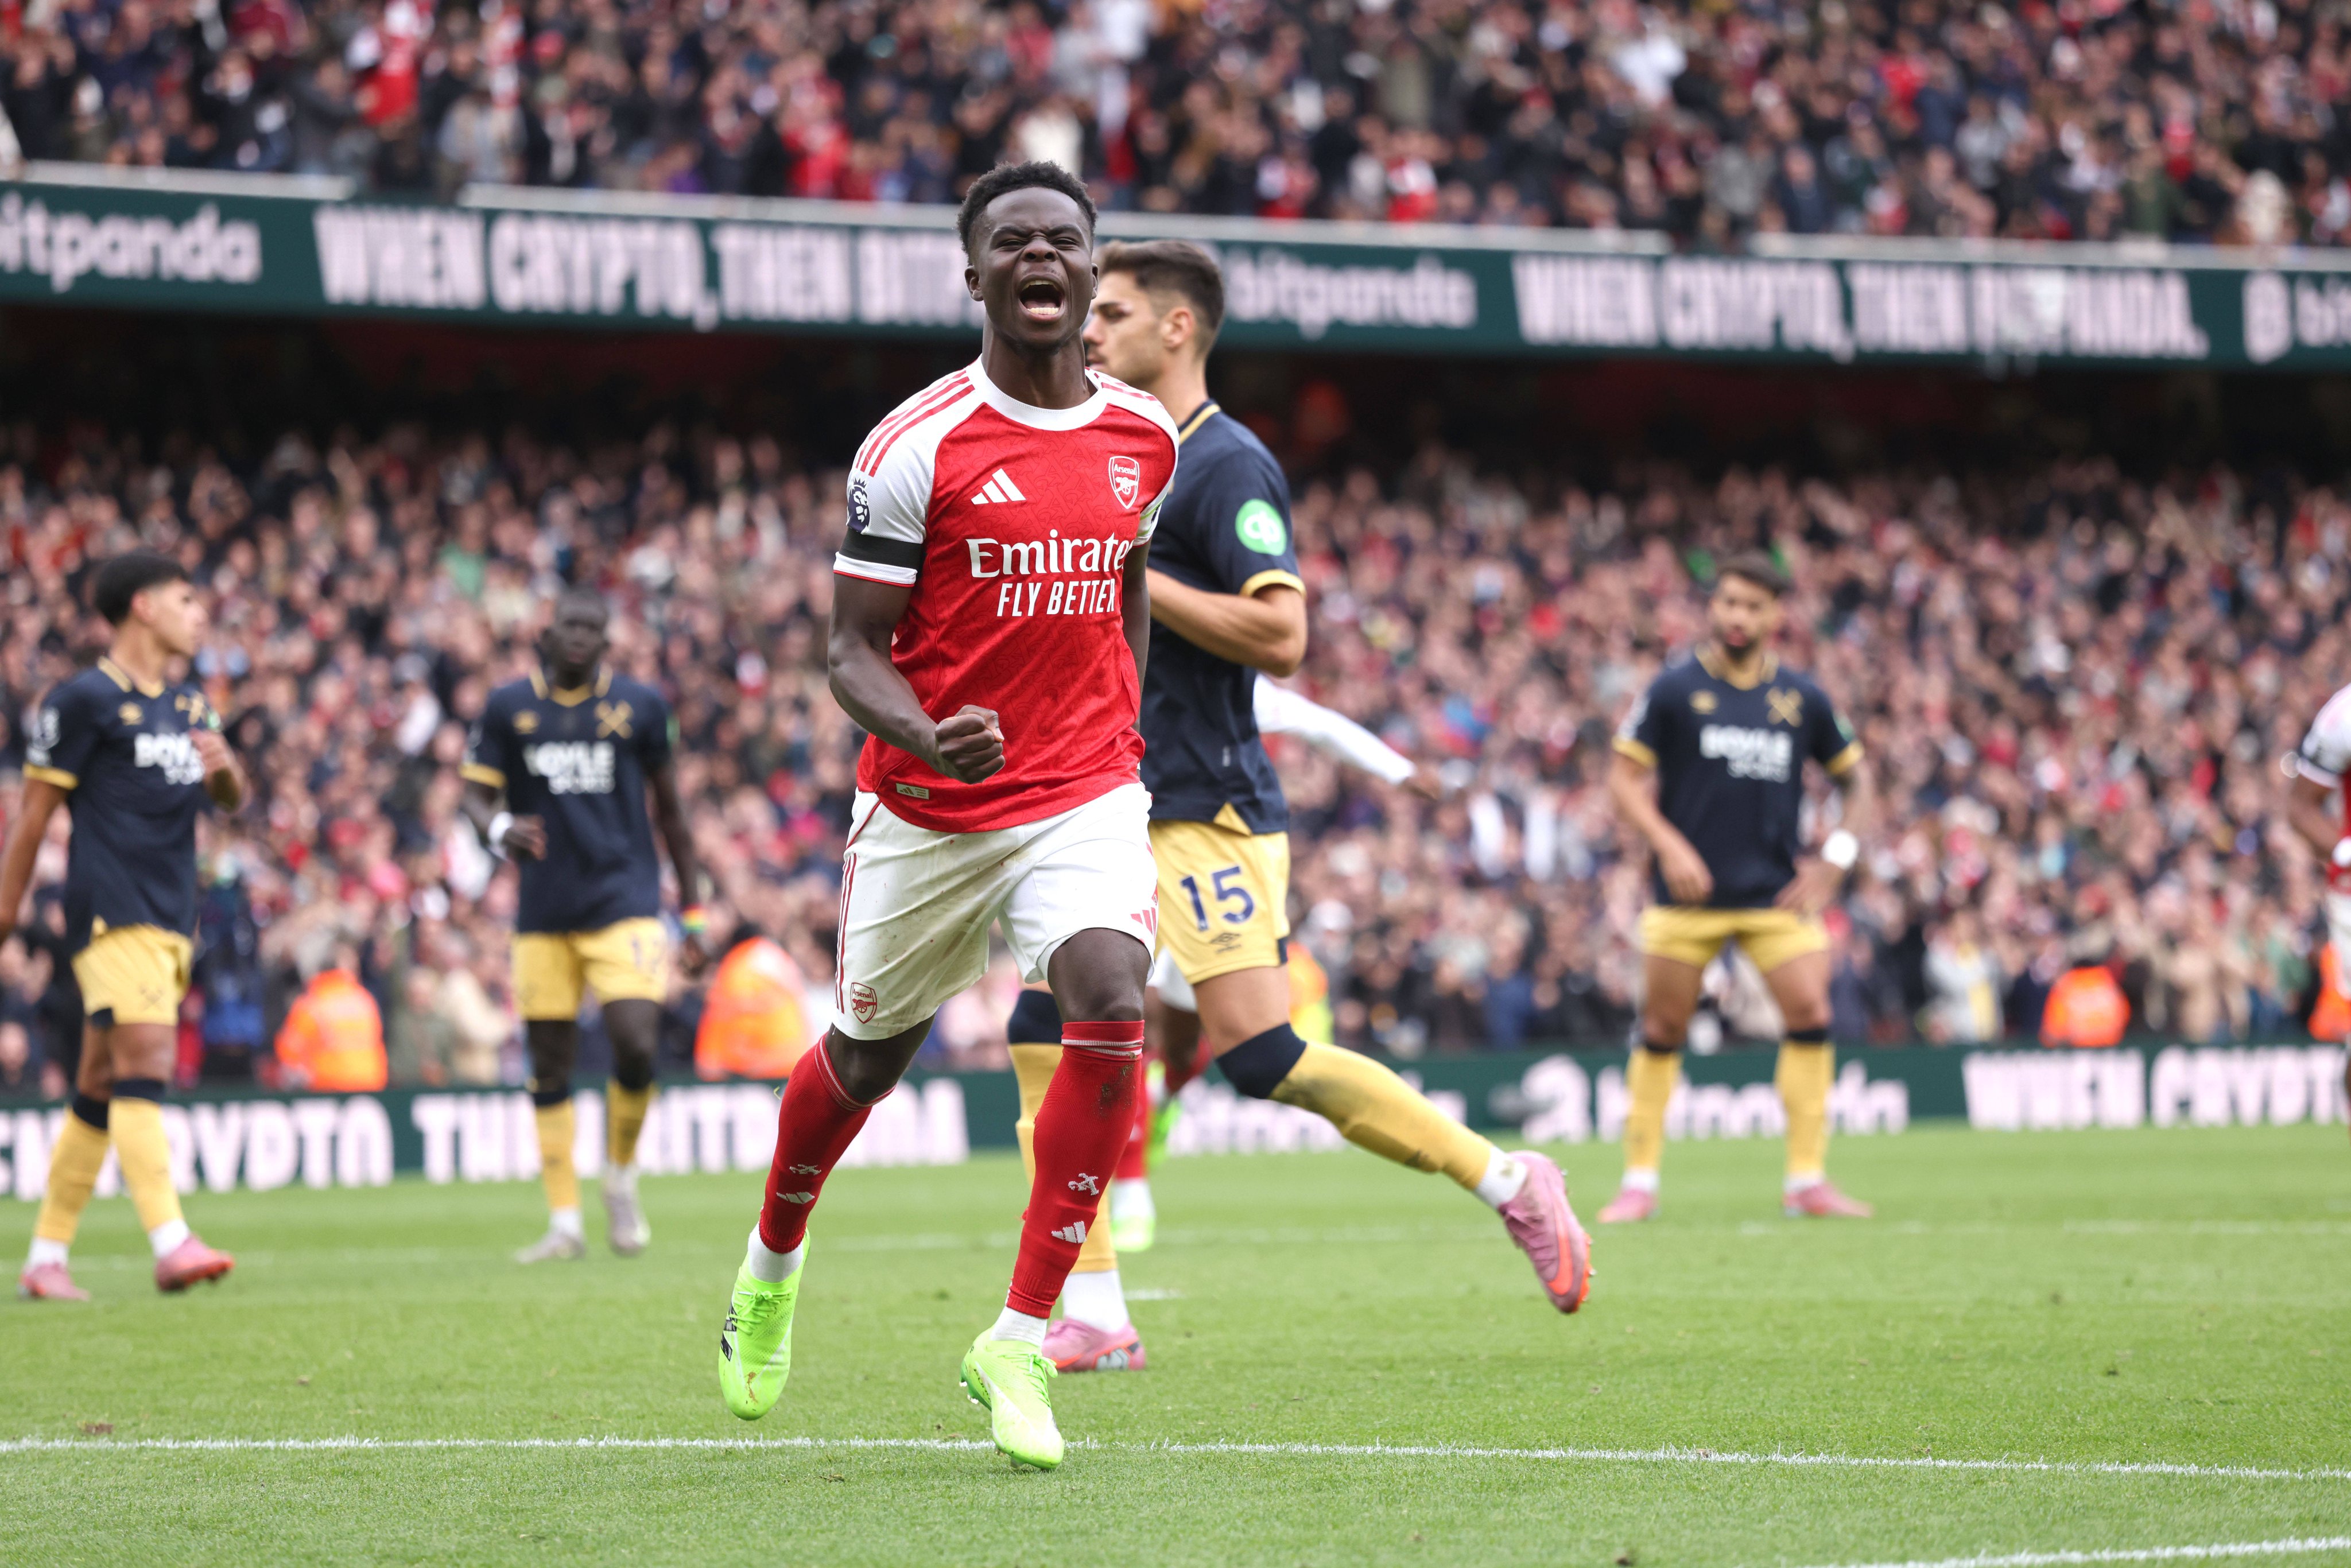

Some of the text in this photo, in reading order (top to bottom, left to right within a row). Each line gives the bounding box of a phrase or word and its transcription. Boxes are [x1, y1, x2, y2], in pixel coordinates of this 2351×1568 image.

[0, 191, 262, 294] itpanda
[313, 202, 488, 310] WHEN
[996, 578, 1115, 617] FLY BETTER
[1180, 865, 1255, 932] 15
[853, 988, 872, 999] Arsenal
